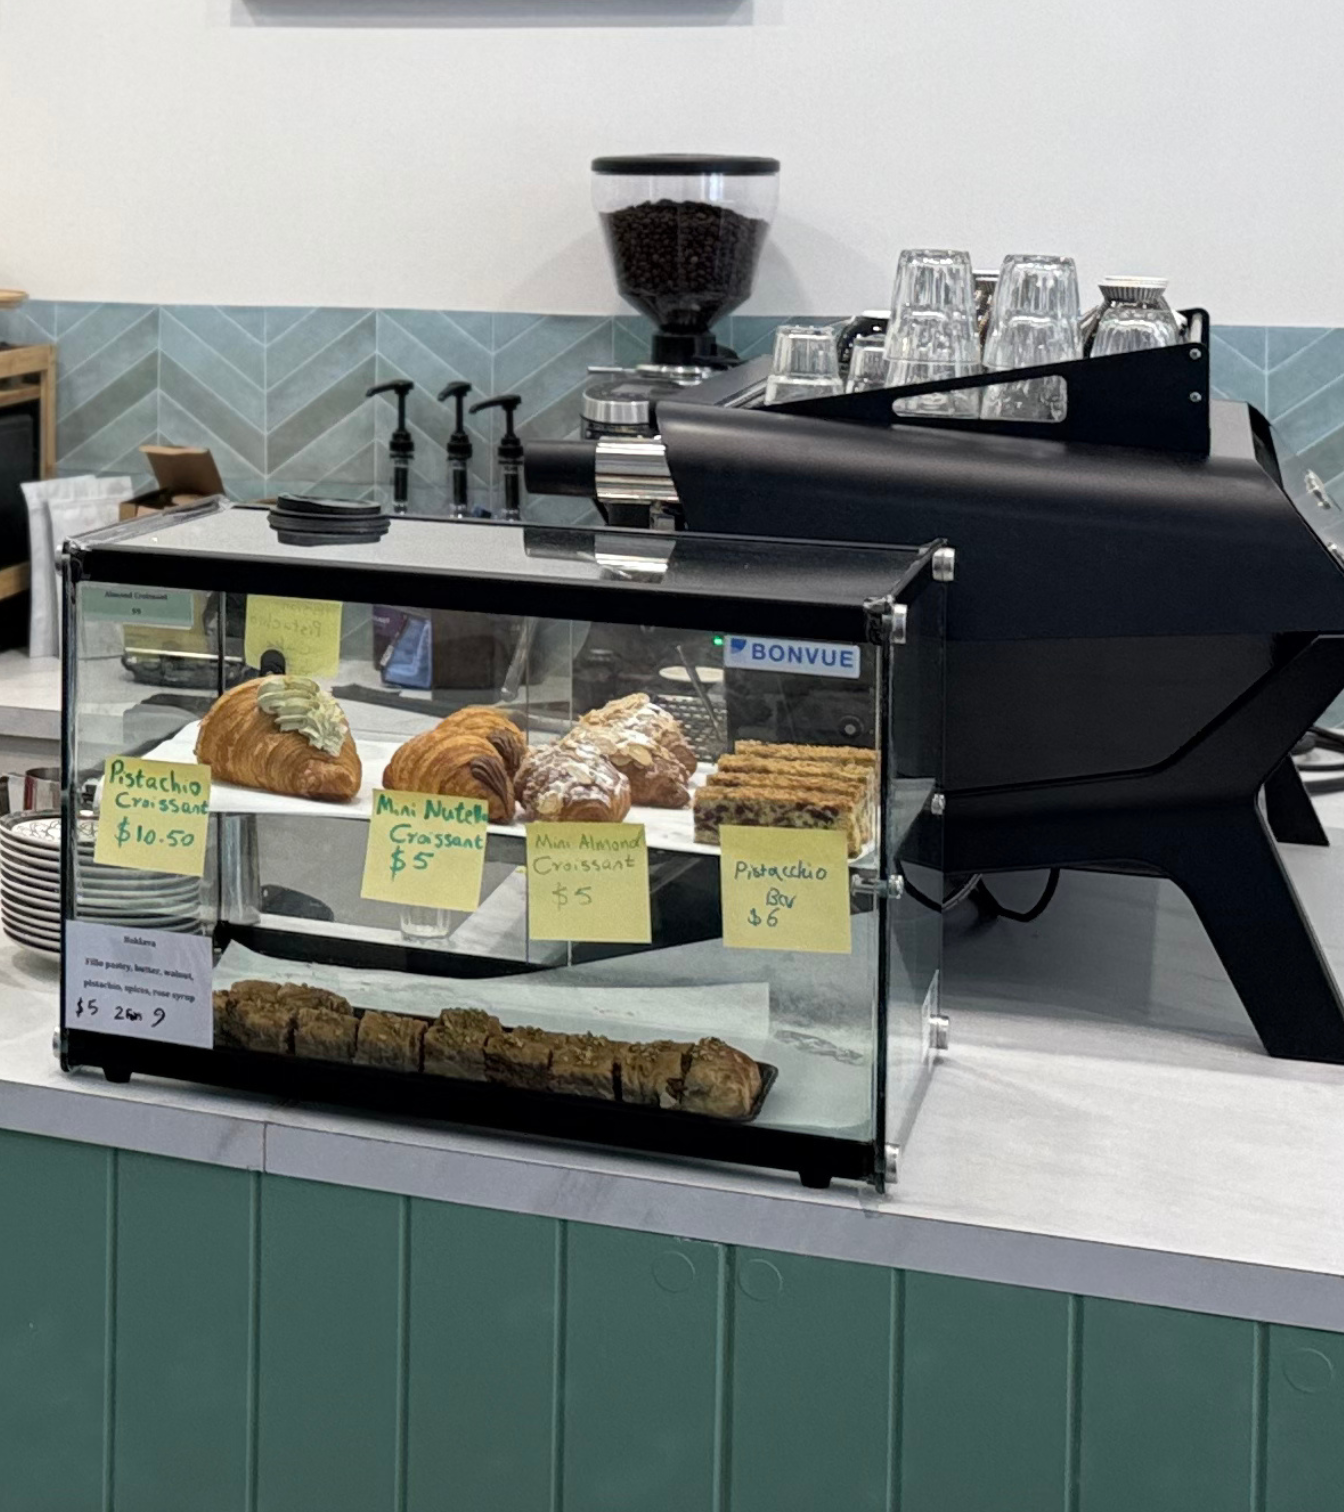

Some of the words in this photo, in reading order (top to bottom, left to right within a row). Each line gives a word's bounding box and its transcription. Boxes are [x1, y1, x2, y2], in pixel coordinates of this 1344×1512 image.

[751, 642, 854, 668] BONVUE
[109, 759, 202, 796] Pistachio
[115, 792, 210, 816] Croissant
[376, 794, 416, 817] Mini
[114, 817, 194, 848] $10.50
[390, 824, 484, 849] Croissant
[535, 834, 572, 849] Mini
[581, 834, 644, 851] Almond
[390, 846, 434, 882] $5
[532, 854, 635, 875] Croissant
[552, 882, 592, 911] $5
[748, 908, 778, 927] $6
